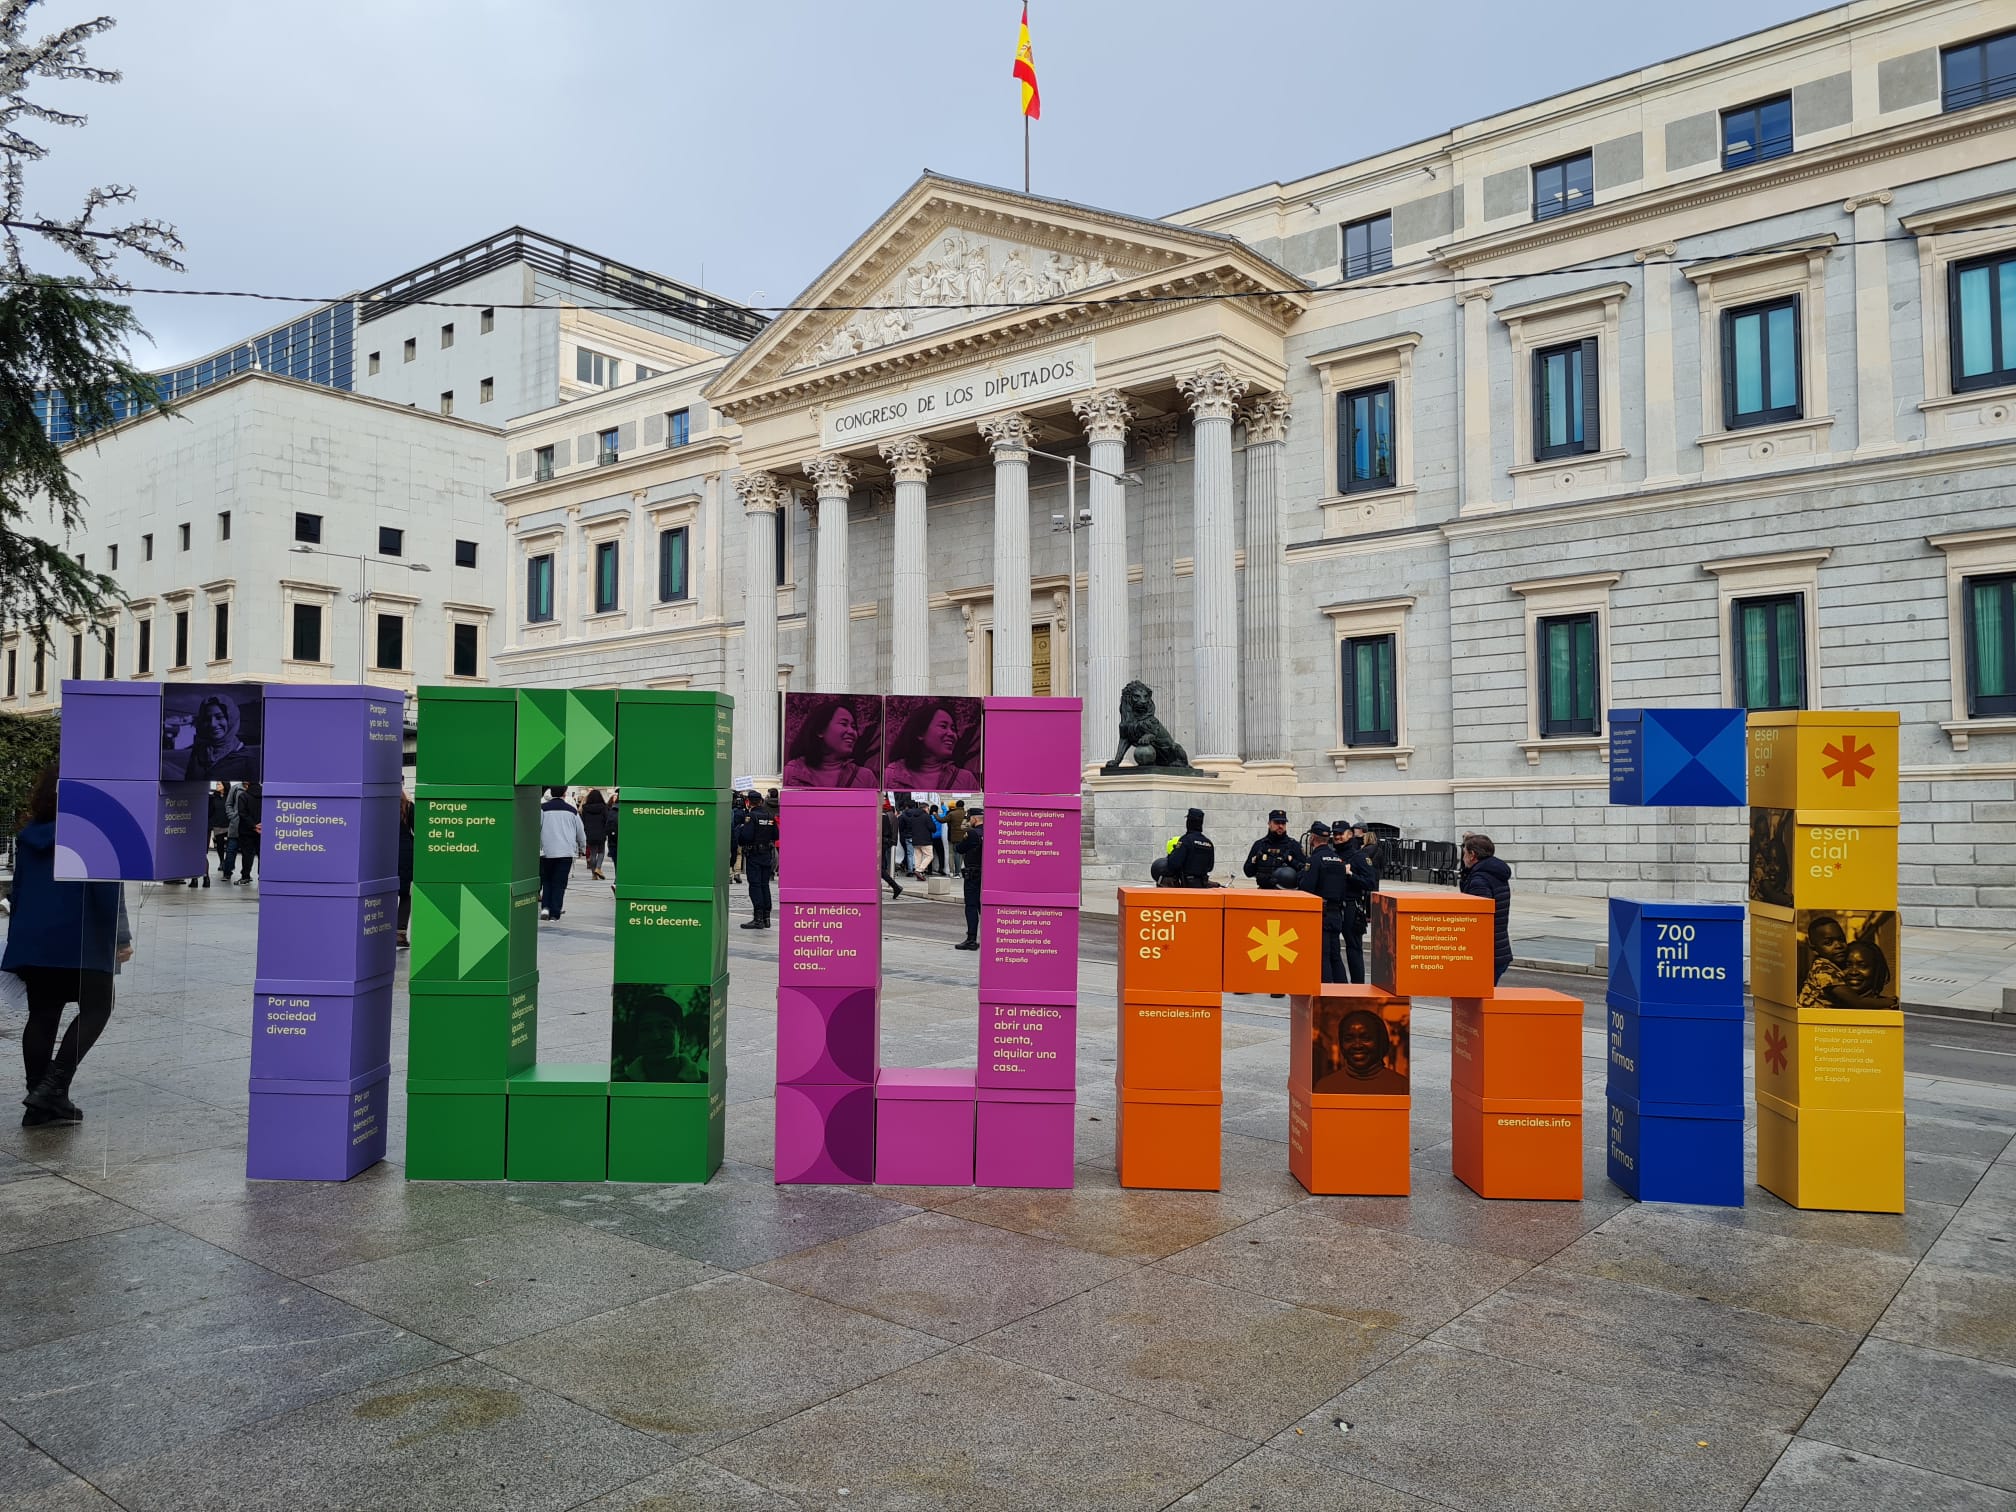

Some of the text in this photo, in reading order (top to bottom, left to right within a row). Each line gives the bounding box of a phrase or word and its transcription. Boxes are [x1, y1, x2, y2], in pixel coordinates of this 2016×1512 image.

[835, 361, 1074, 432] CONGRESO DE LOS DIPUTADOS
[276, 800, 317, 811] Iguales
[429, 801, 468, 813] Porque
[632, 805, 705, 816] esenciales.info
[275, 813, 347, 827] obligaciones,
[428, 816, 496, 828] somos parte
[275, 827, 314, 839] iguales
[428, 828, 455, 838] de la
[1810, 828, 1860, 841] esen
[274, 841, 326, 852] derechos.
[428, 842, 480, 853] sociedad.
[1810, 841, 1848, 860] cial
[630, 902, 668, 914] Porque
[794, 906, 862, 917] Ir al médico,
[629, 915, 702, 927] es lo decente.
[1140, 909, 1187, 923] esen
[794, 919, 843, 929] abrir una
[1139, 923, 1175, 941] cial
[1656, 924, 1696, 942] 700
[793, 934, 833, 945] cuenta,
[793, 947, 857, 959] alquilar una
[1656, 942, 1688, 960] mil
[793, 962, 826, 970] casa...
[1656, 960, 1726, 980] firmas
[268, 997, 310, 1007] Por una
[267, 1011, 317, 1022] sociedad
[994, 1007, 1062, 1019] Ir al médico,
[1138, 1008, 1211, 1019] esenciales.info
[994, 1020, 1043, 1031] abrir una
[1611, 1011, 1624, 1031] 700
[266, 1024, 307, 1035] diversa
[993, 1036, 1033, 1047] cuenta,
[1611, 1029, 1622, 1048] mil
[993, 1048, 1057, 1061] alquilar una
[1611, 1046, 1634, 1073] firmas
[993, 1064, 1026, 1072] casa...
[1497, 1116, 1572, 1128] esenciales.info
